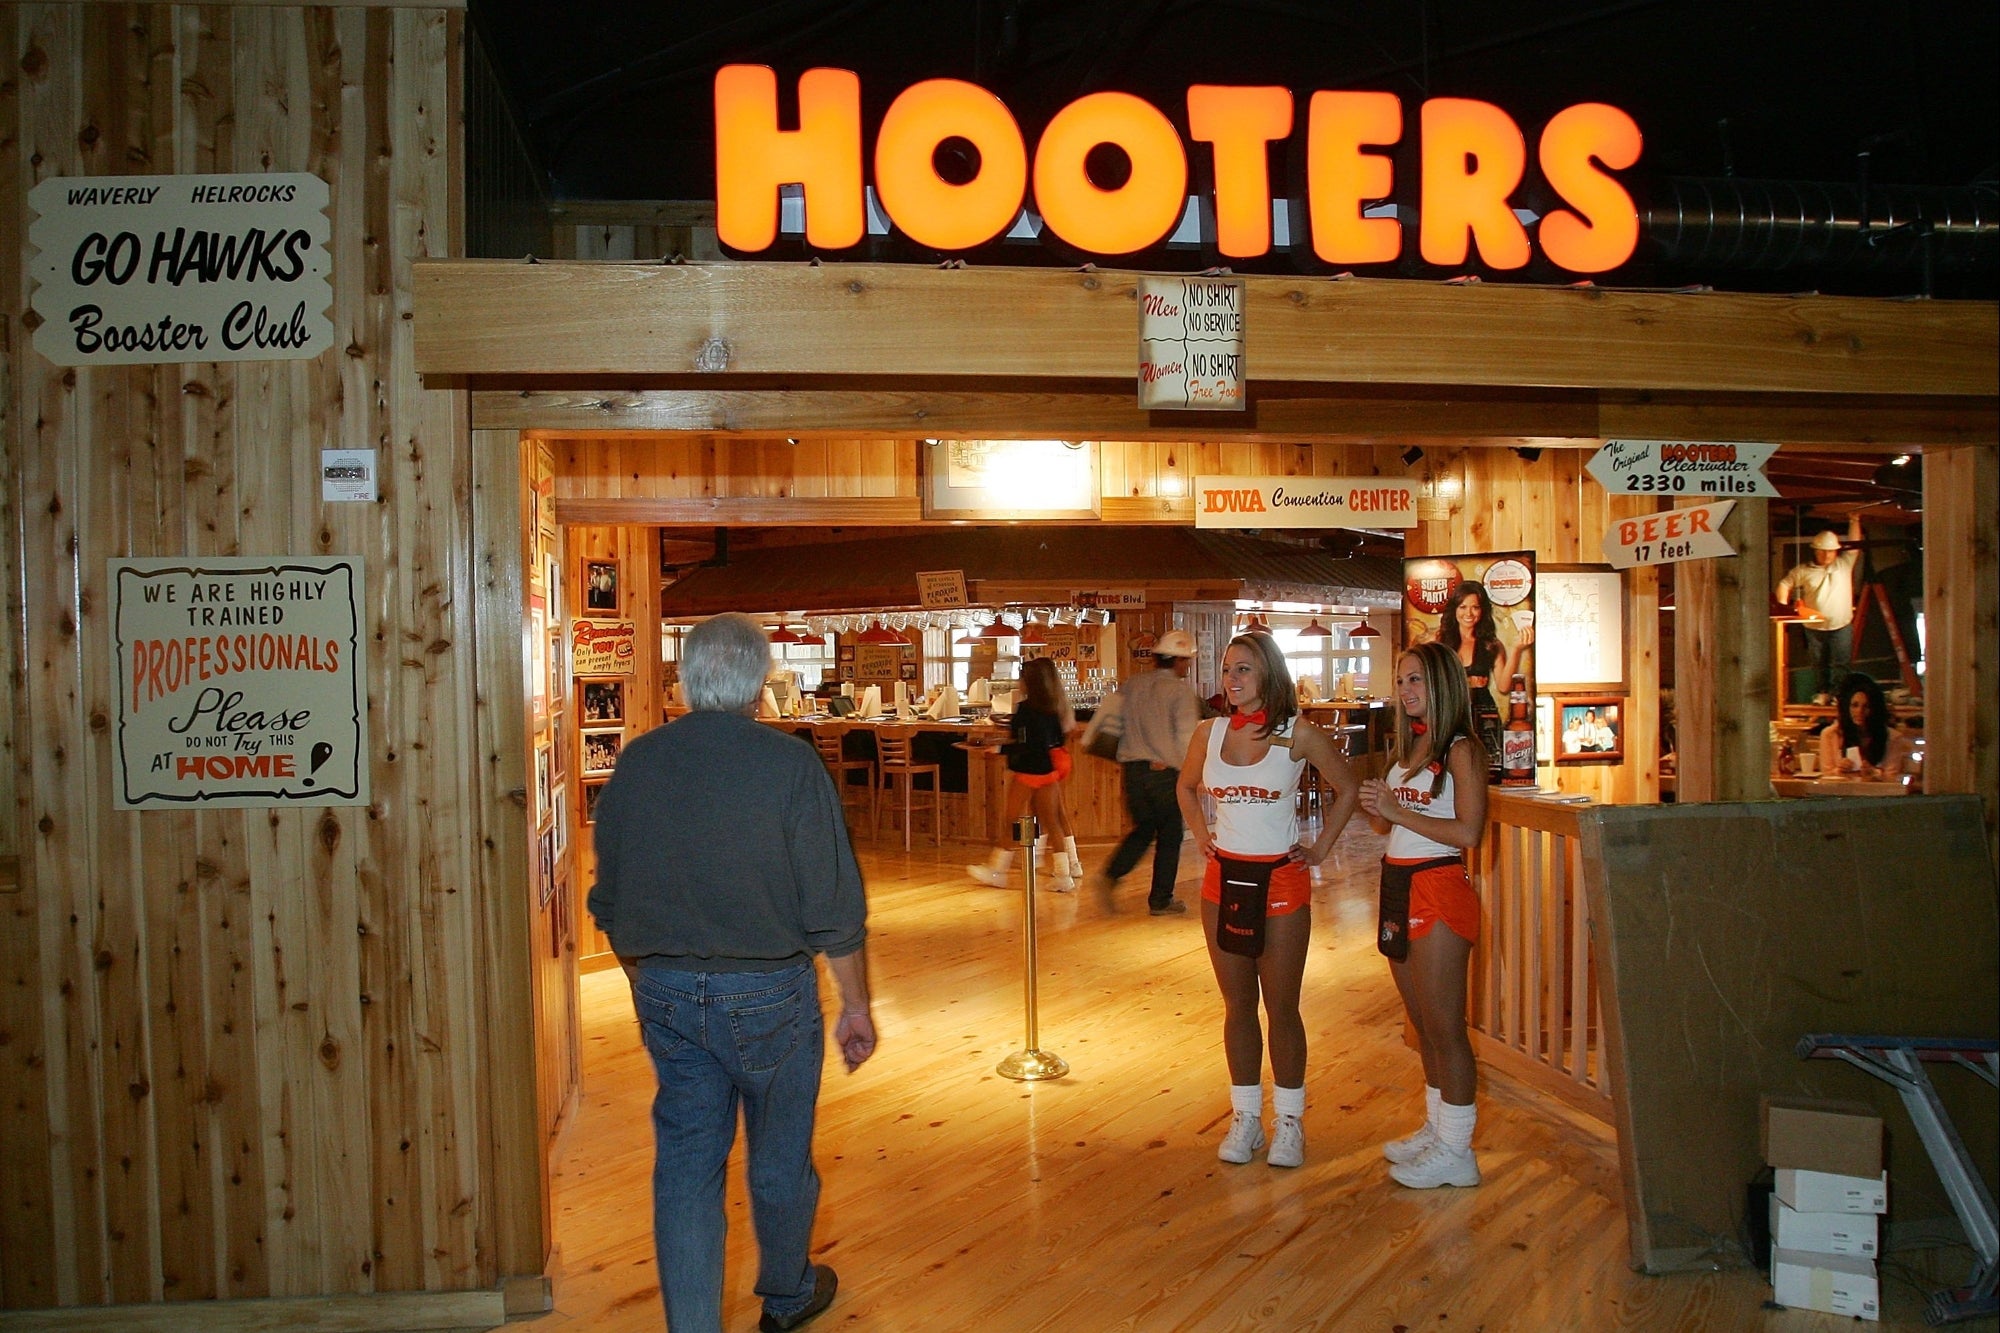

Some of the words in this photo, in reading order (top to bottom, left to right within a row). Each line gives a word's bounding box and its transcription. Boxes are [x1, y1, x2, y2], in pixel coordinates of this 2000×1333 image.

[714, 63, 1644, 274] HOOTERS
[68, 186, 160, 206] WAVERLY
[191, 185, 296, 203] HELROCKS
[71, 231, 141, 286] GO
[147, 226, 311, 286] HAWKS
[1143, 293, 1178, 316] Men
[1189, 283, 1203, 307] NO
[1206, 283, 1238, 311] SHIRT
[68, 304, 208, 354] Booster
[221, 300, 311, 351] Club
[1189, 312, 1201, 331] NO
[1204, 313, 1240, 336] SERVICE
[1140, 361, 1182, 382] Women
[1192, 353, 1206, 377] NO
[1210, 354, 1240, 381] SHIRT
[1189, 380, 1213, 401] Free
[1604, 441, 1625, 457] The
[1612, 445, 1650, 471] Original
[1661, 444, 1737, 462] HOOTERS
[1659, 460, 1750, 473] Clearwater
[1626, 474, 1686, 492] 2330
[1701, 475, 1757, 493] miles
[1203, 489, 1267, 513] IOWA
[1272, 487, 1345, 508] Convention
[1349, 488, 1411, 512] CENTER
[1619, 508, 1712, 546] BEER
[1634, 546, 1650, 562] 17
[1660, 541, 1691, 558] feet
[144, 583, 176, 603] WE
[191, 583, 235, 602] ARE
[251, 580, 327, 601] HIGHLY
[1421, 579, 1448, 591] SUPER
[1123, 594, 1145, 604] Blvd.
[1421, 590, 1449, 604] PARTY
[187, 605, 284, 626] TRAINED
[573, 621, 634, 652] Remember
[576, 647, 591, 656] Only
[592, 640, 614, 653] YOU
[1050, 646, 1070, 660] CARD
[588, 654, 611, 665] prevent
[132, 633, 339, 713] PROFESSIONALS
[168, 687, 311, 733] Please
[186, 736, 201, 748] DO
[205, 735, 227, 747] NOT
[233, 732, 262, 756] Try
[269, 734, 294, 747] THIS
[151, 752, 173, 773] AT
[176, 754, 296, 780] HOME
[1208, 785, 1281, 800] OOTERS
